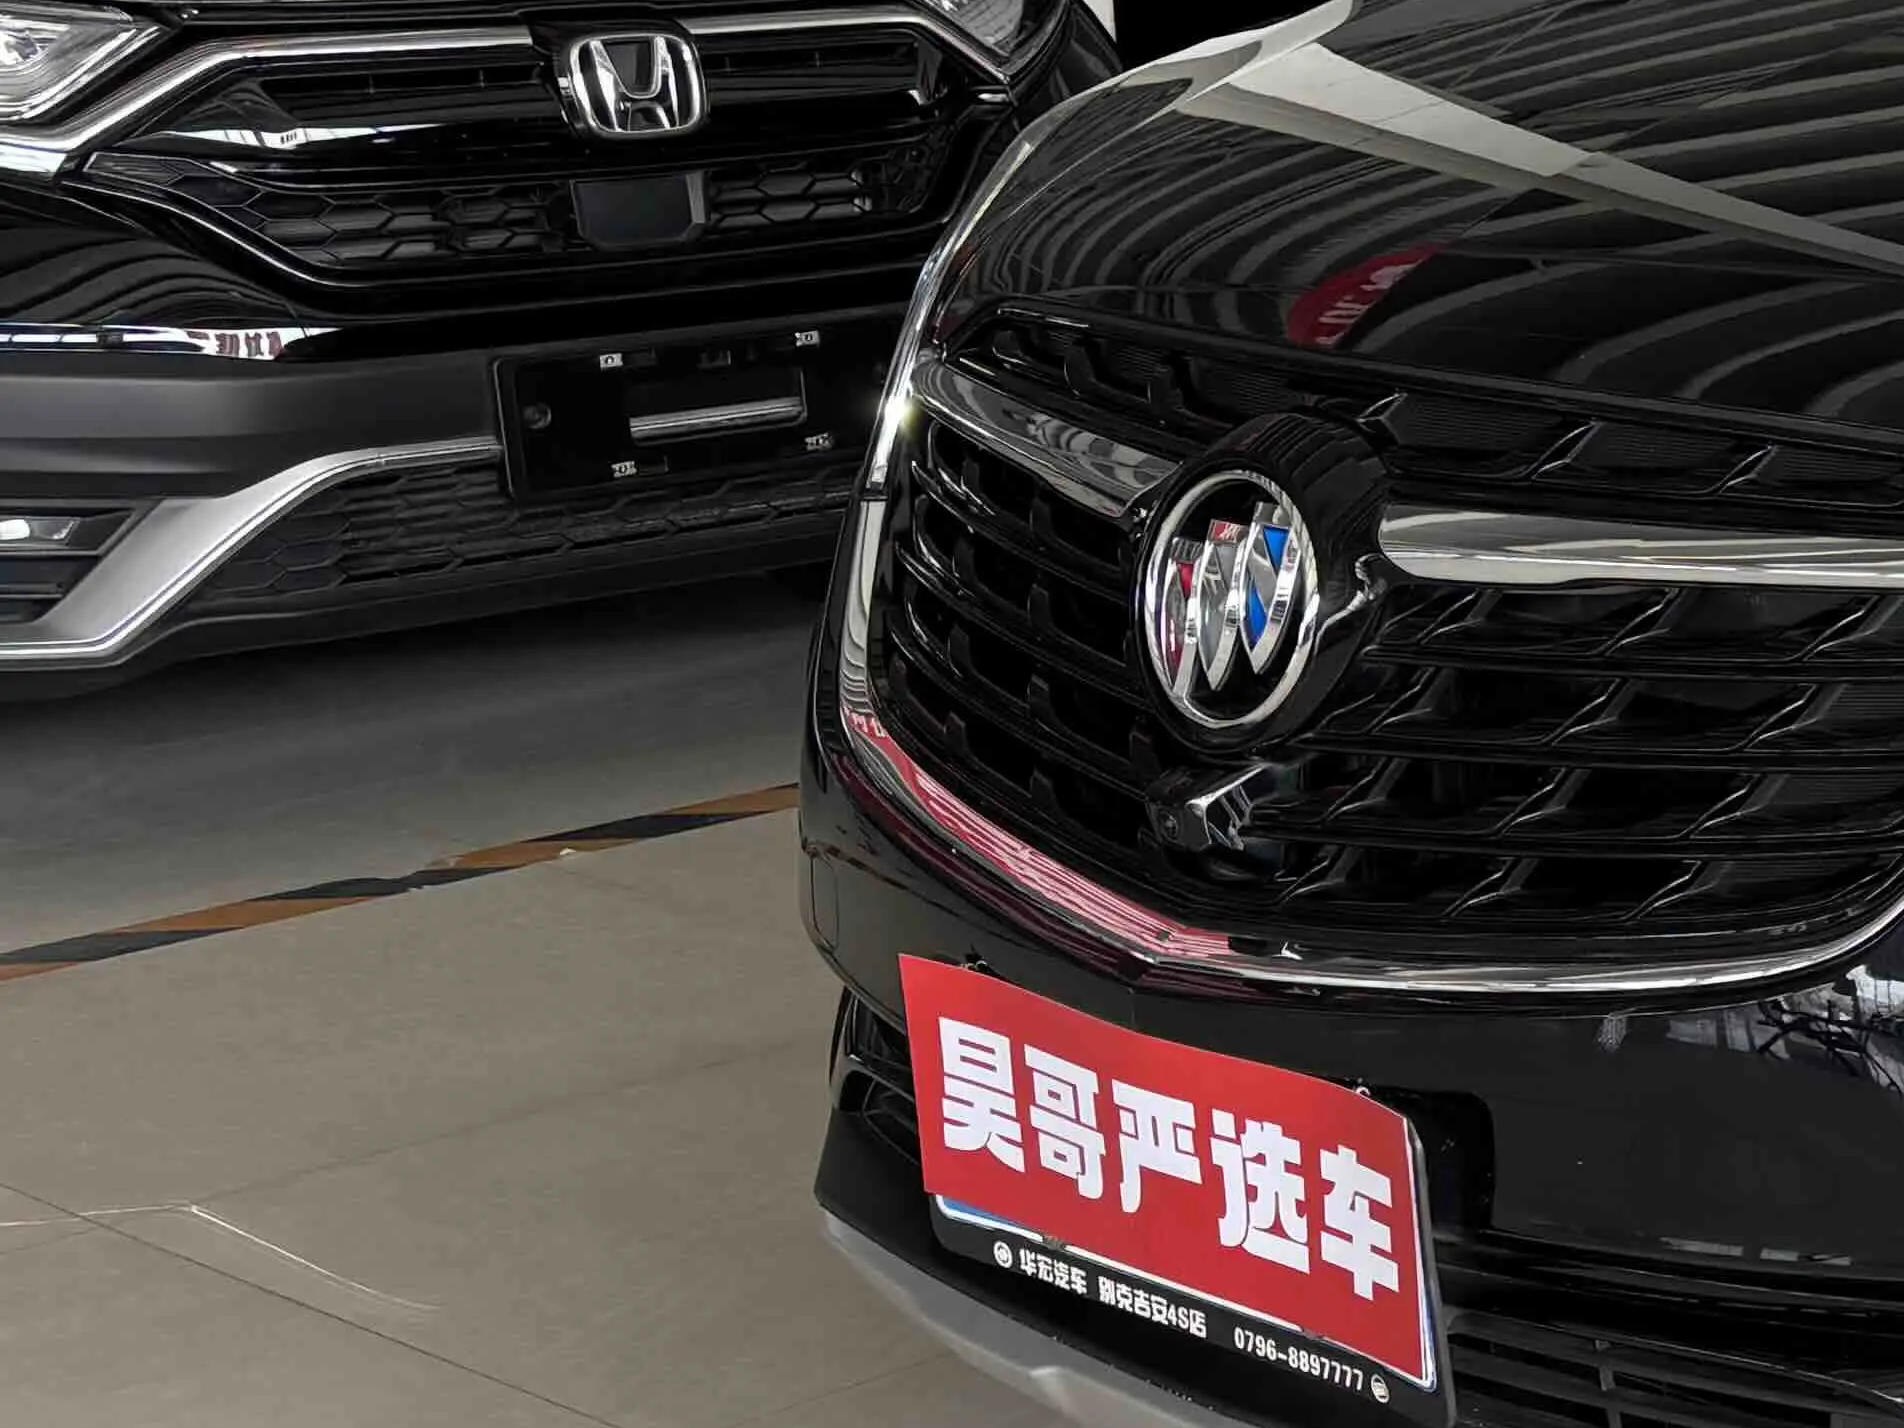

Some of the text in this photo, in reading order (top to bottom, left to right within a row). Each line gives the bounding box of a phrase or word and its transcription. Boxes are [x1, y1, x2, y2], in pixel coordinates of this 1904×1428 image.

[938, 1016, 1400, 1303] 昊哥严选车
[1098, 1275, 1207, 1339] 别克吉安4S店
[1233, 1327, 1364, 1391] 0796-8897777
